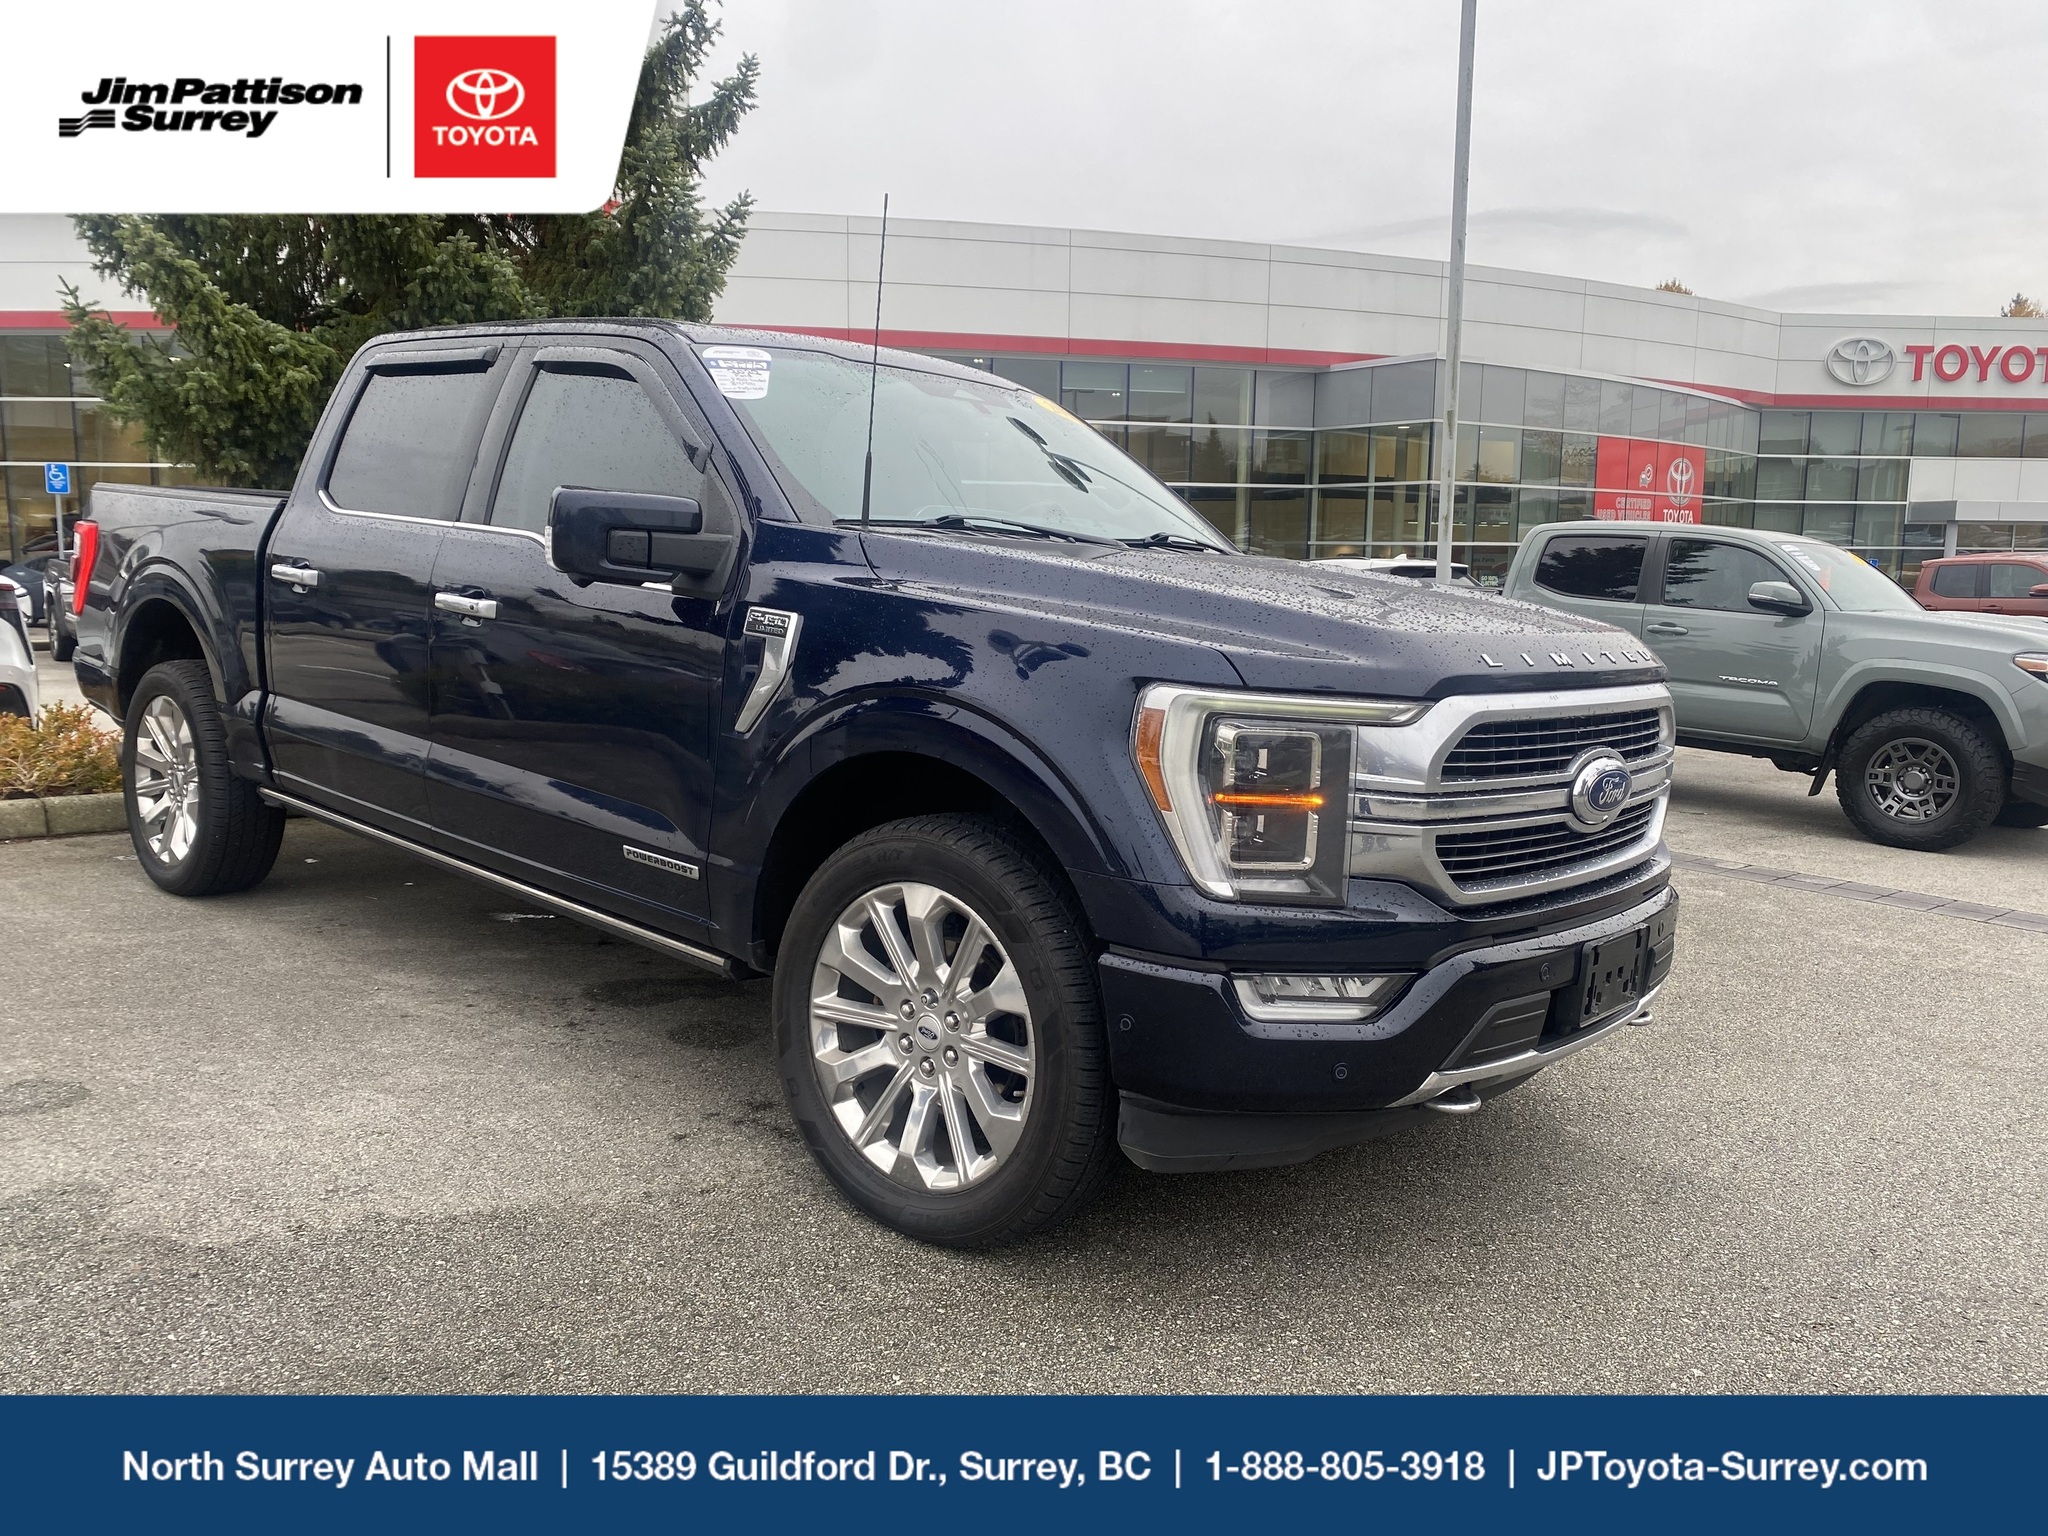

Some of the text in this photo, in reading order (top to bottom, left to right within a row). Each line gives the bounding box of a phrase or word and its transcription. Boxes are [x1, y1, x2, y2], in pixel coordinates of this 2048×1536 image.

[1615, 497, 1652, 510] CERTIFIED
[1663, 509, 1694, 524] TOYOTA
[1480, 650, 1653, 668] LIMITED
[1718, 675, 1779, 686] TACOMA
[1599, 776, 1626, 805] Ford
[625, 848, 695, 875] POWERBOOST
